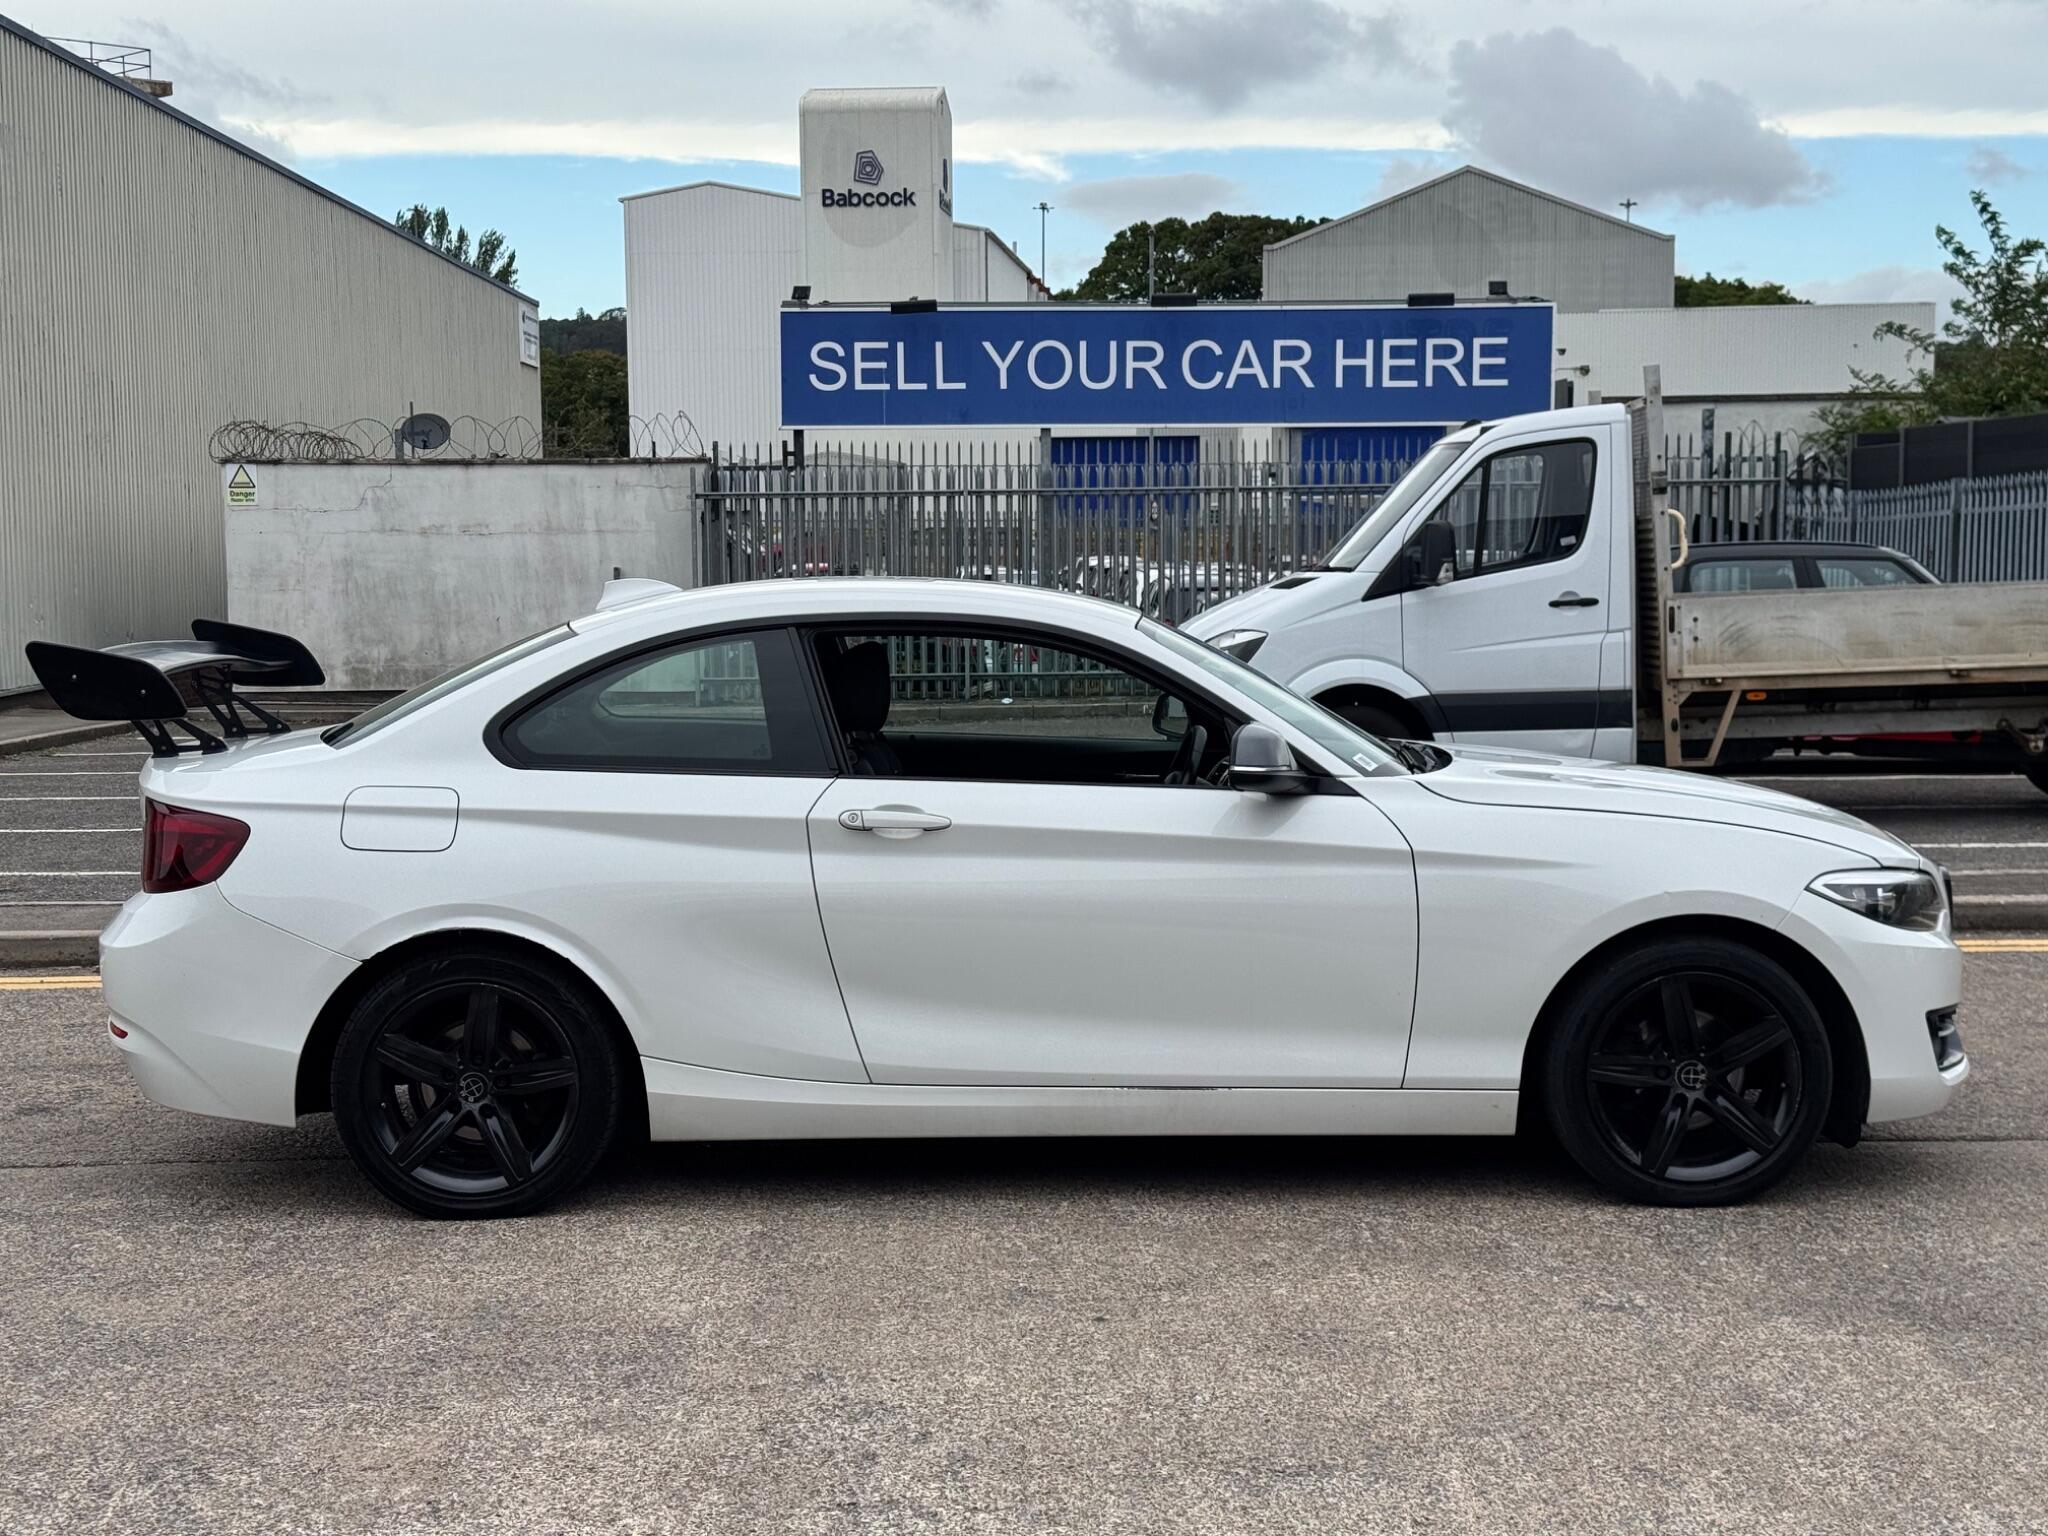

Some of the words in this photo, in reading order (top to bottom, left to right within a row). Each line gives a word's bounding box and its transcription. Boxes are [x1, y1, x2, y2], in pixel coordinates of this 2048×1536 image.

[821, 187, 916, 208] Babcock
[808, 340, 968, 392] SELL
[982, 339, 1168, 391] YOUR
[1181, 338, 1315, 390] CAR
[1335, 336, 1509, 389] HERE
[229, 490, 255, 498] Danger
